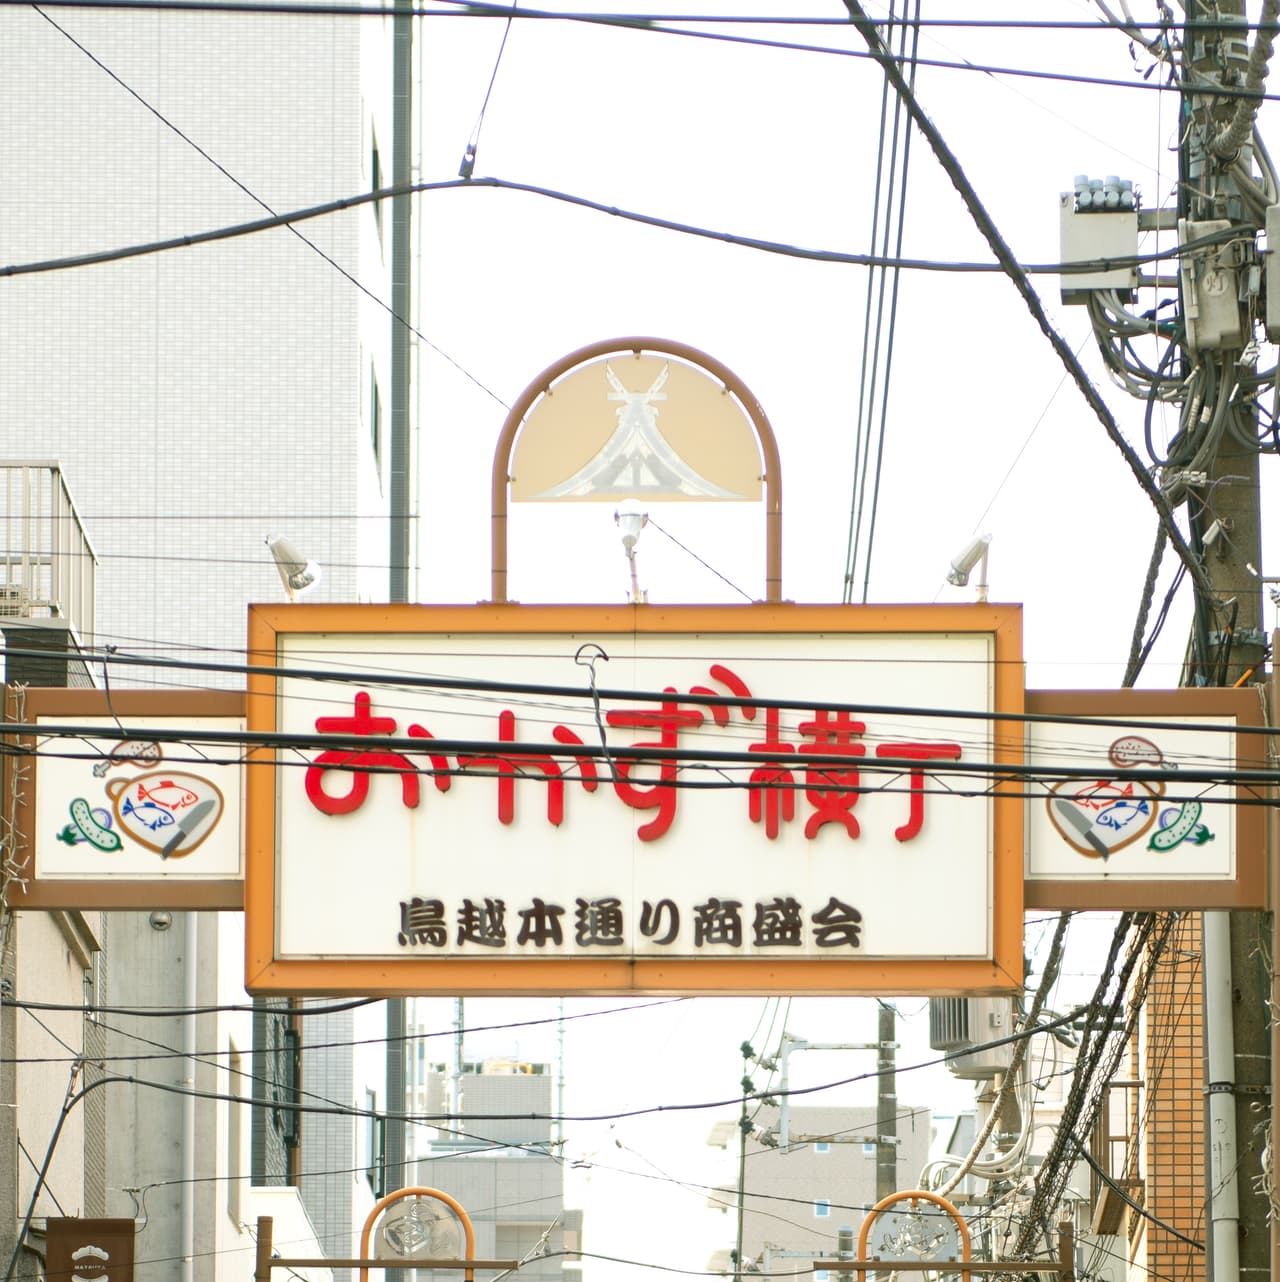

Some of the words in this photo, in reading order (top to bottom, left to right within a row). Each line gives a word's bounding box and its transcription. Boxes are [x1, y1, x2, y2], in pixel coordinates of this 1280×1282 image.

[305, 664, 961, 842] おかず横丁
[396, 897, 863, 948] 鳥越本通り商盛会
